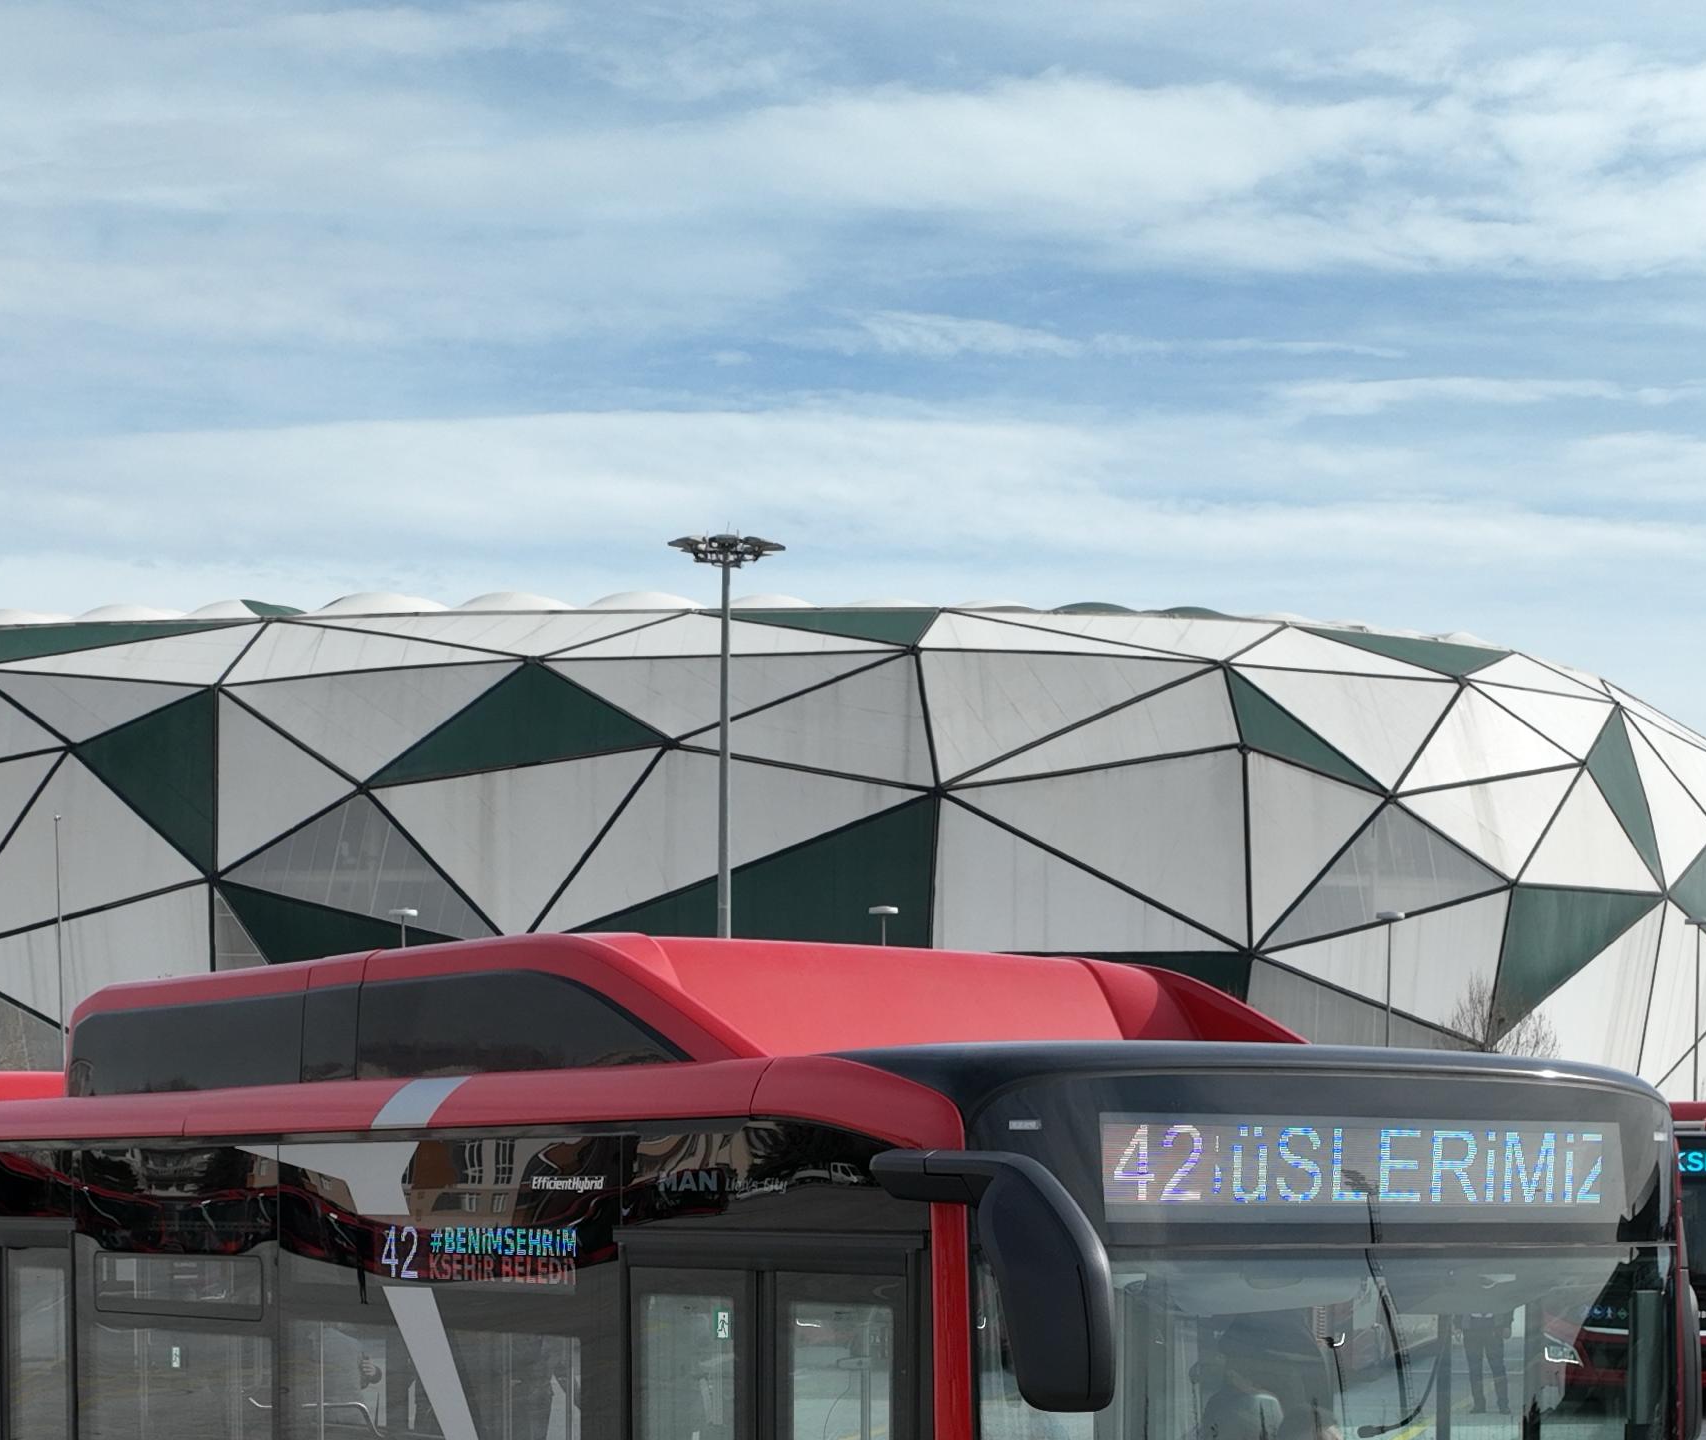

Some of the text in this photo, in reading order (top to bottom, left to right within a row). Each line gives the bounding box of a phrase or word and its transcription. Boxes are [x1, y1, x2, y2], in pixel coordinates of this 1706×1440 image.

[657, 1170, 719, 1193] MAN
[1113, 1124, 1603, 1204] 42 ÜSLERİMİZ
[531, 1175, 604, 1194] EfficientHybrid
[381, 1225, 419, 1280] 42
